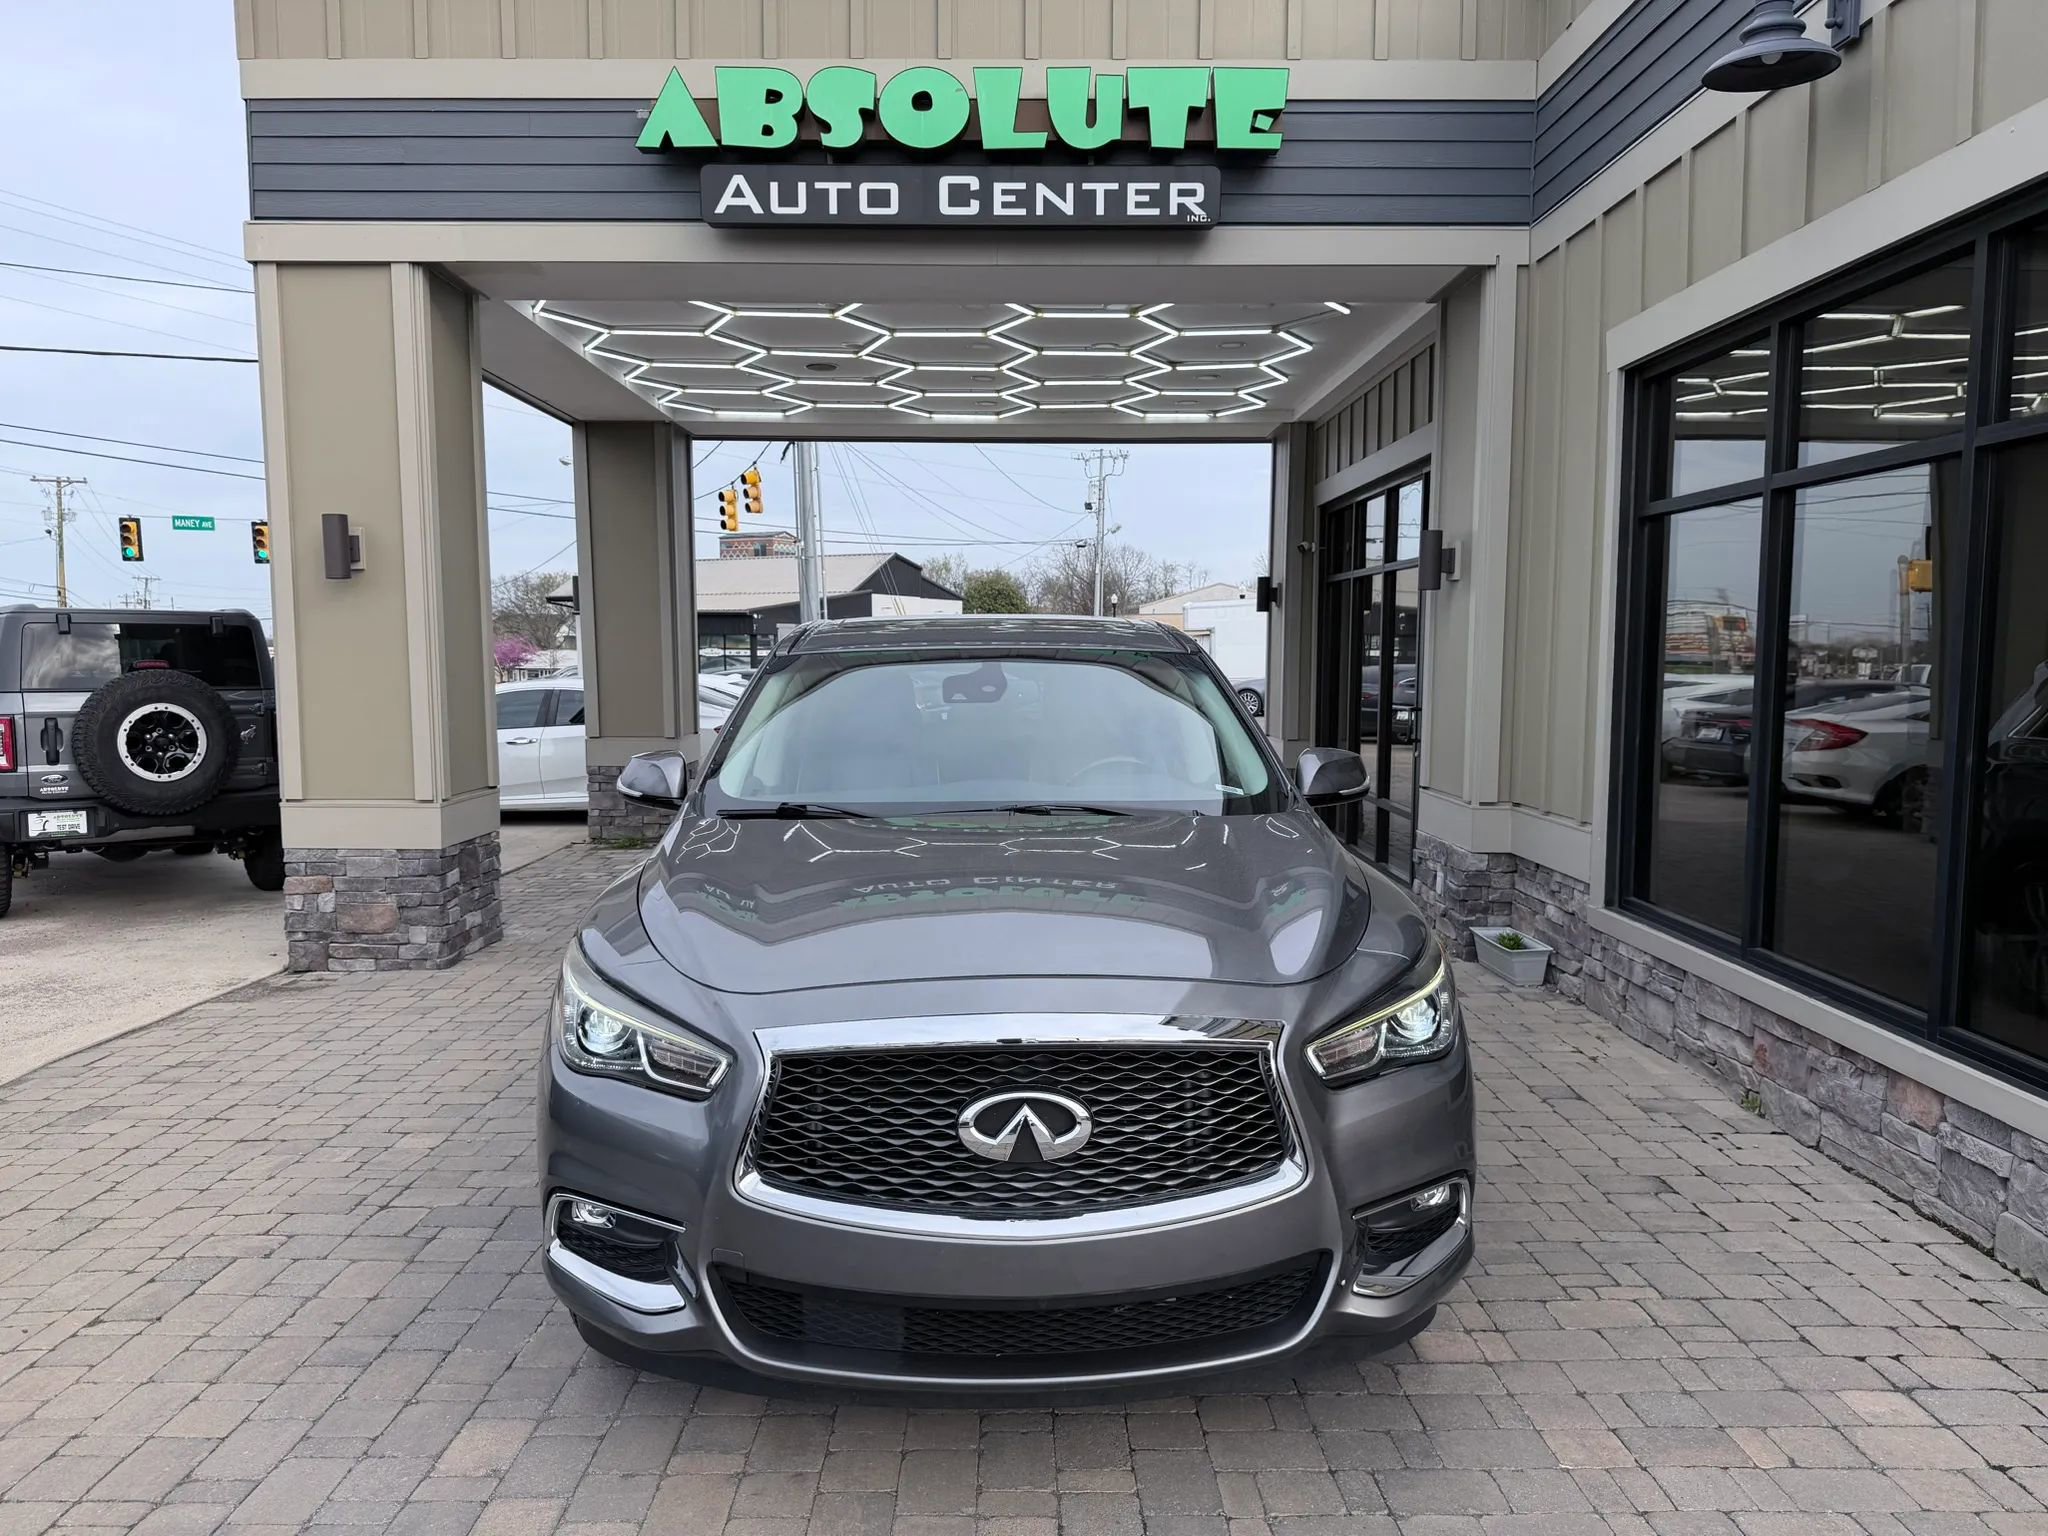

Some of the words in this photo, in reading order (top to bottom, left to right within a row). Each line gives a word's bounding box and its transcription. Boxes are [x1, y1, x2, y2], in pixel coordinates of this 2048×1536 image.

[635, 65, 1291, 151] ABSOLUTE
[713, 174, 899, 215] AUTO
[938, 175, 1207, 215] CENTER
[1187, 214, 1211, 222] INC.
[175, 518, 200, 528] MANEY
